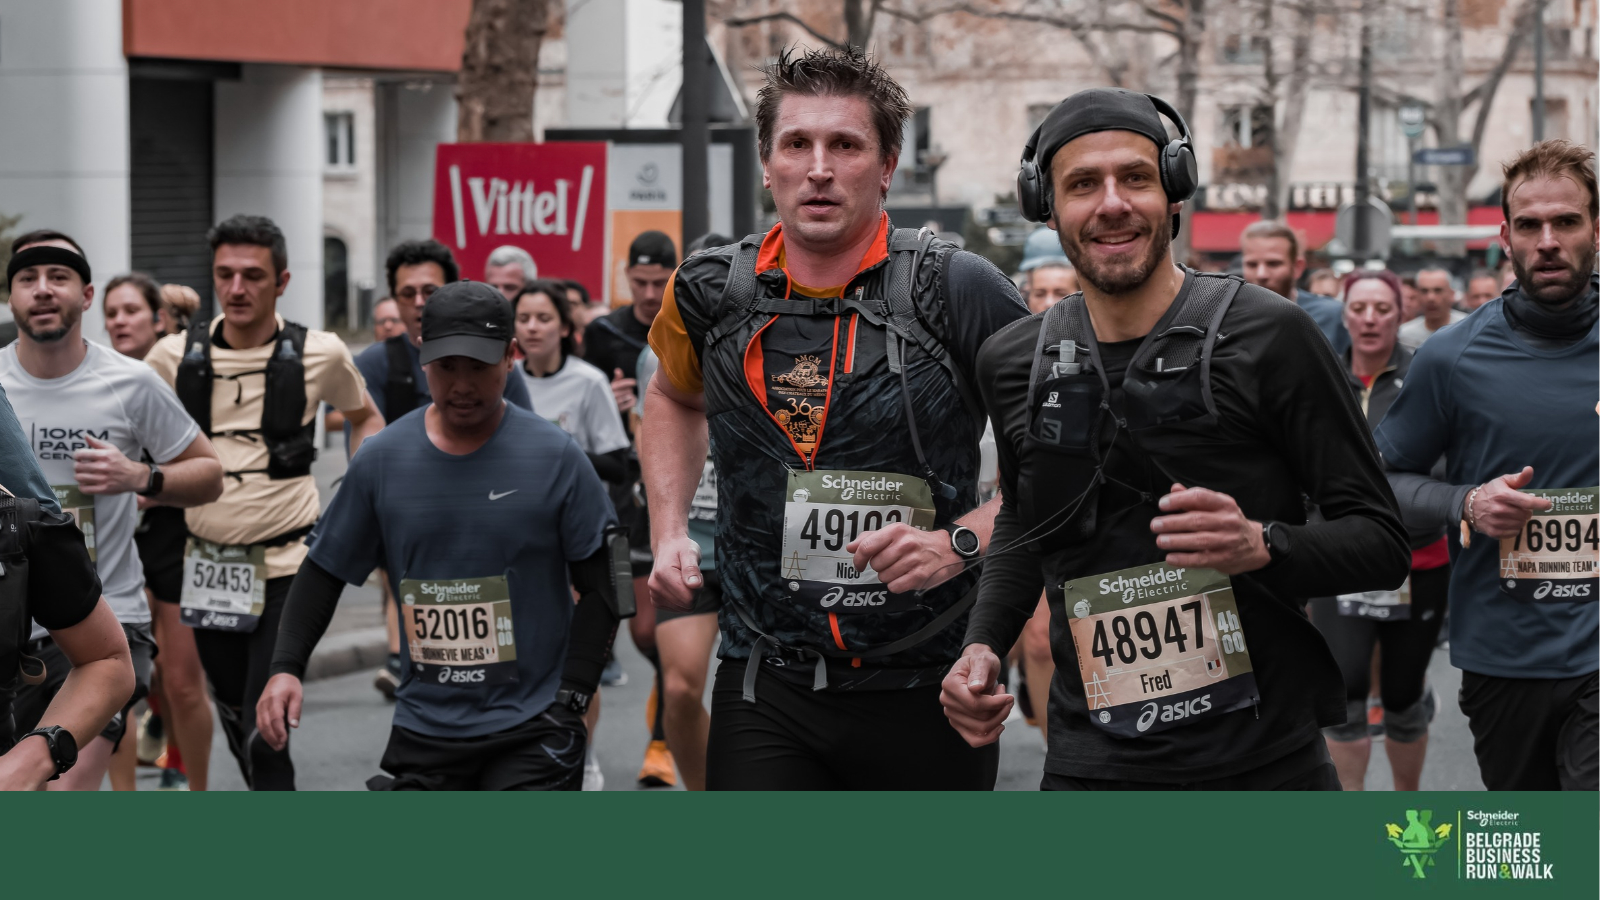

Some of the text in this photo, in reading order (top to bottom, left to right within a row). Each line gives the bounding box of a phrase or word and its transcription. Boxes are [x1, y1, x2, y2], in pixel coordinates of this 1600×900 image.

[468, 177, 569, 236] Vittel
[795, 355, 821, 365] AMCM
[787, 397, 811, 416] 36
[39, 428, 109, 440] 10KM
[39, 441, 91, 451] PAR
[821, 474, 903, 492] Schneider
[856, 491, 901, 500] Electric
[1518, 561, 1592, 573] NAPA RUNNING TEAM
[193, 562, 251, 593] 52453
[1099, 568, 1186, 595] Schneider
[421, 582, 481, 595] Schneider
[1137, 583, 1188, 600] Electric
[1552, 583, 1591, 597] asics
[843, 591, 887, 607] asics
[414, 607, 488, 640] 52016
[497, 617, 512, 631] 4h
[1217, 609, 1240, 633] 4h
[498, 631, 513, 646] 00
[1091, 600, 1204, 668] 48947
[1222, 631, 1246, 655] 00
[461, 647, 485, 661] MEAS
[451, 669, 485, 683] asics
[1140, 670, 1172, 694] Fred
[1160, 694, 1212, 723] asics
